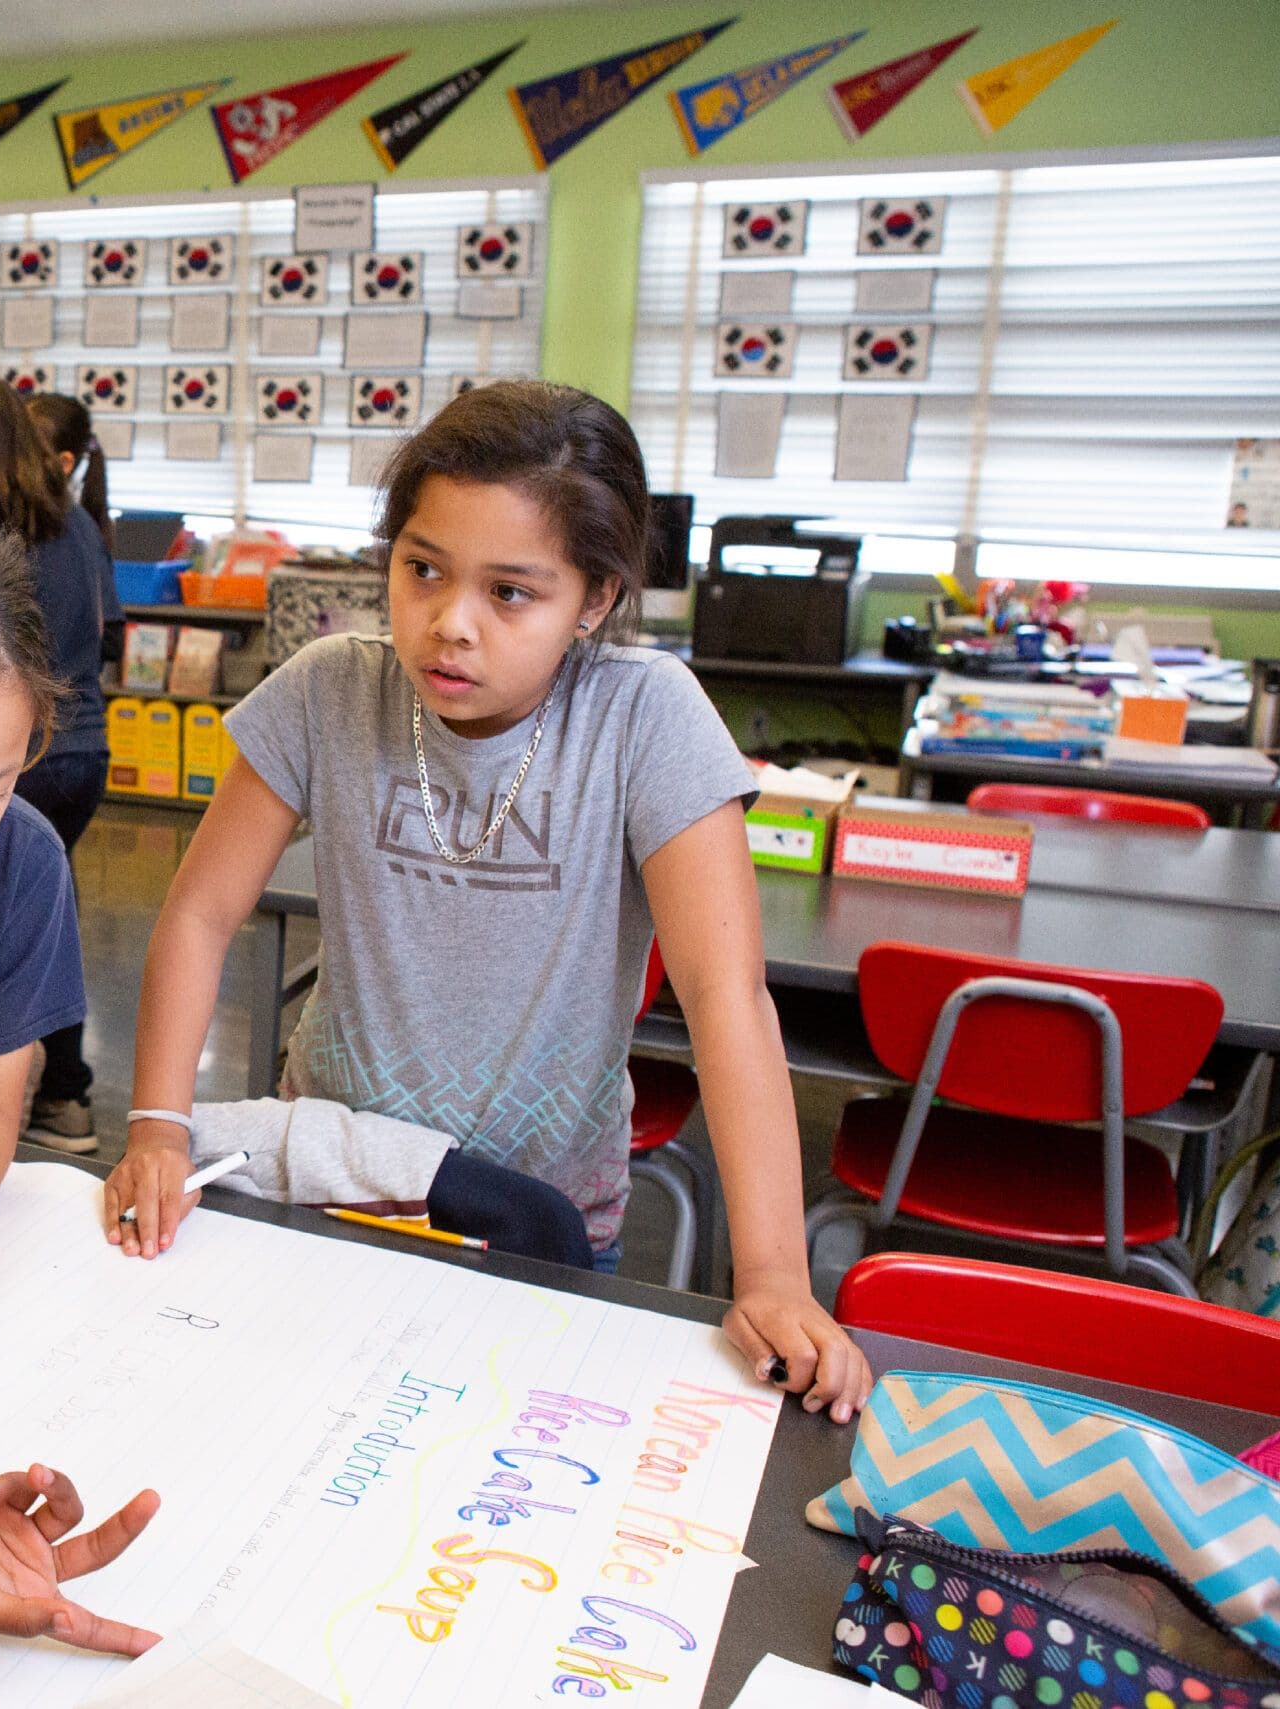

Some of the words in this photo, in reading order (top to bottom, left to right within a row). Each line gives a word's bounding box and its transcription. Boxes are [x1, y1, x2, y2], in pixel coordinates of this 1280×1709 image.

[376, 775, 552, 861] RUN
[319, 1369, 468, 1508] Introduction
[512, 1387, 633, 1445] Rice
[632, 1378, 777, 1493] Korean
[457, 1448, 602, 1528] Cake
[375, 1533, 558, 1645] Soup
[602, 1503, 743, 1587] Rice
[551, 1595, 698, 1699] Cake
